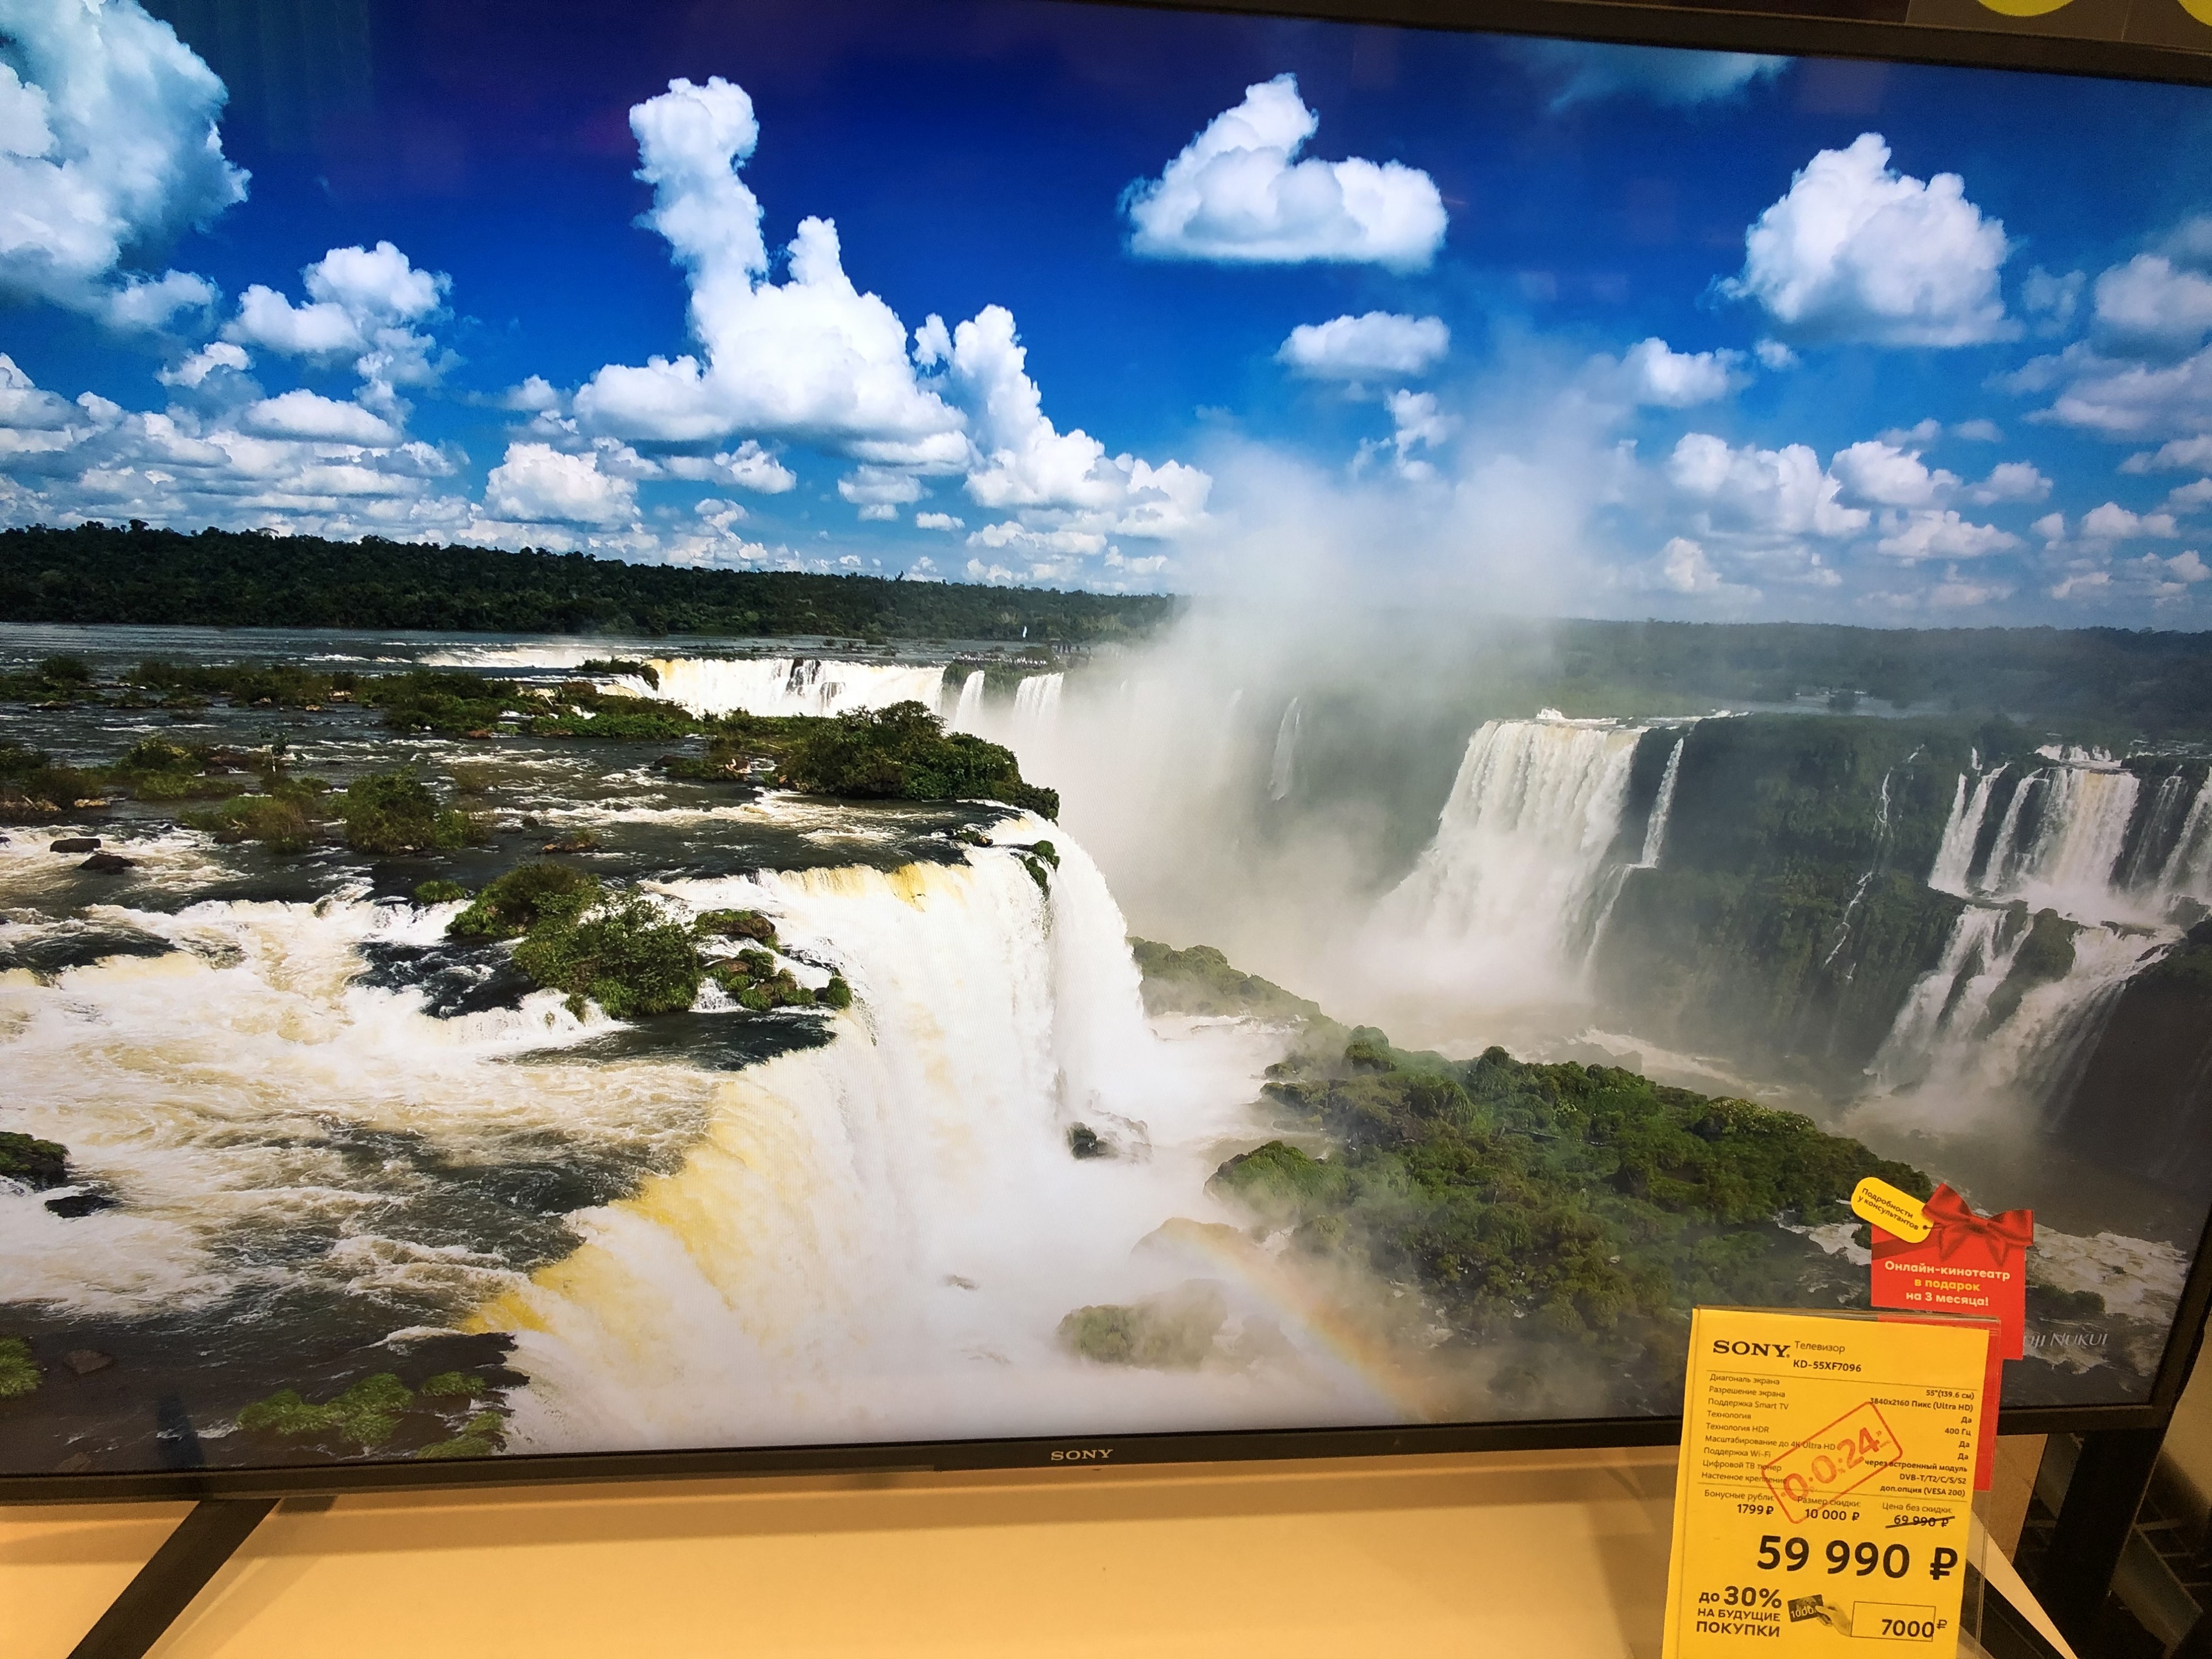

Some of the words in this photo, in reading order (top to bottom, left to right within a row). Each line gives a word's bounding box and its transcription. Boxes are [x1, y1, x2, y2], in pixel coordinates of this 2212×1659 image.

[1862, 1188, 1913, 1218] Подробности
[1864, 1198, 1918, 1230] консультантов
[1885, 1260, 2010, 1282] Онлайн-кинотеатр
[1925, 1280, 1980, 1292] подарок
[1906, 1292, 1922, 1301] на
[1925, 1292, 1933, 1301] 3
[1936, 1295, 1989, 1307] месяца!
[1794, 1340, 1845, 1355] Телевизор
[1793, 1359, 1861, 1373] KD-55XF7096
[1709, 1374, 1751, 1384] Диагональ
[1753, 1377, 1780, 1386] экрана
[1709, 1386, 1756, 1396] Разрешение
[1759, 1390, 1785, 1398] экрана
[1708, 1398, 1752, 1408] Поддержка
[1755, 1401, 1776, 1410] Smart
[1912, 1400, 1931, 1408] Пикс
[1933, 1401, 1956, 1411] (Ultra
[1958, 1404, 1973, 1412] HD)
[1707, 1410, 1751, 1420] Технология
[1705, 1422, 1750, 1432] Технология
[1961, 1428, 1971, 1437] Гц
[1705, 1435, 1777, 1447] Масштабирование
[1803, 1442, 1822, 1450] Ultra
[1051, 1449, 1114, 1461] SONY
[1704, 1447, 1748, 1457] Поддержка
[1703, 1459, 1744, 1470] Цифровой
[1757, 1464, 1782, 1473] тюнер
[1888, 1461, 1937, 1470] встроенный
[1702, 1472, 1743, 1481] Настенное
[1745, 1476, 1787, 1484] крепление
[1900, 1473, 1966, 1484] DVB-T/T2/C/S/S2
[1704, 1489, 1745, 1500] Бонусные
[1747, 1494, 1775, 1502] рубли:
[1924, 1487, 1947, 1496] (VESA
[1948, 1489, 1965, 1498] 200)
[1797, 1496, 1828, 1507] Размер
[1830, 1499, 1861, 1507] скидки:
[1805, 1509, 1818, 1519] 10
[1822, 1509, 1847, 1521] 000
[1882, 1503, 1903, 1511] Цена
[1906, 1503, 1920, 1511] без
[1922, 1506, 1953, 1515] скидки:
[1894, 1515, 1909, 1525] 69
[1913, 1516, 1936, 1526] 990
[1757, 1535, 1809, 1571] 59
[1825, 1540, 1910, 1578] 990
[1699, 1592, 1720, 1604] до
[1724, 1585, 1782, 1609] 30%
[1697, 1608, 1715, 1618] НА
[1718, 1609, 1781, 1622] БУДУЩИЕ
[1696, 1621, 1780, 1637] ПОКУПКИ
